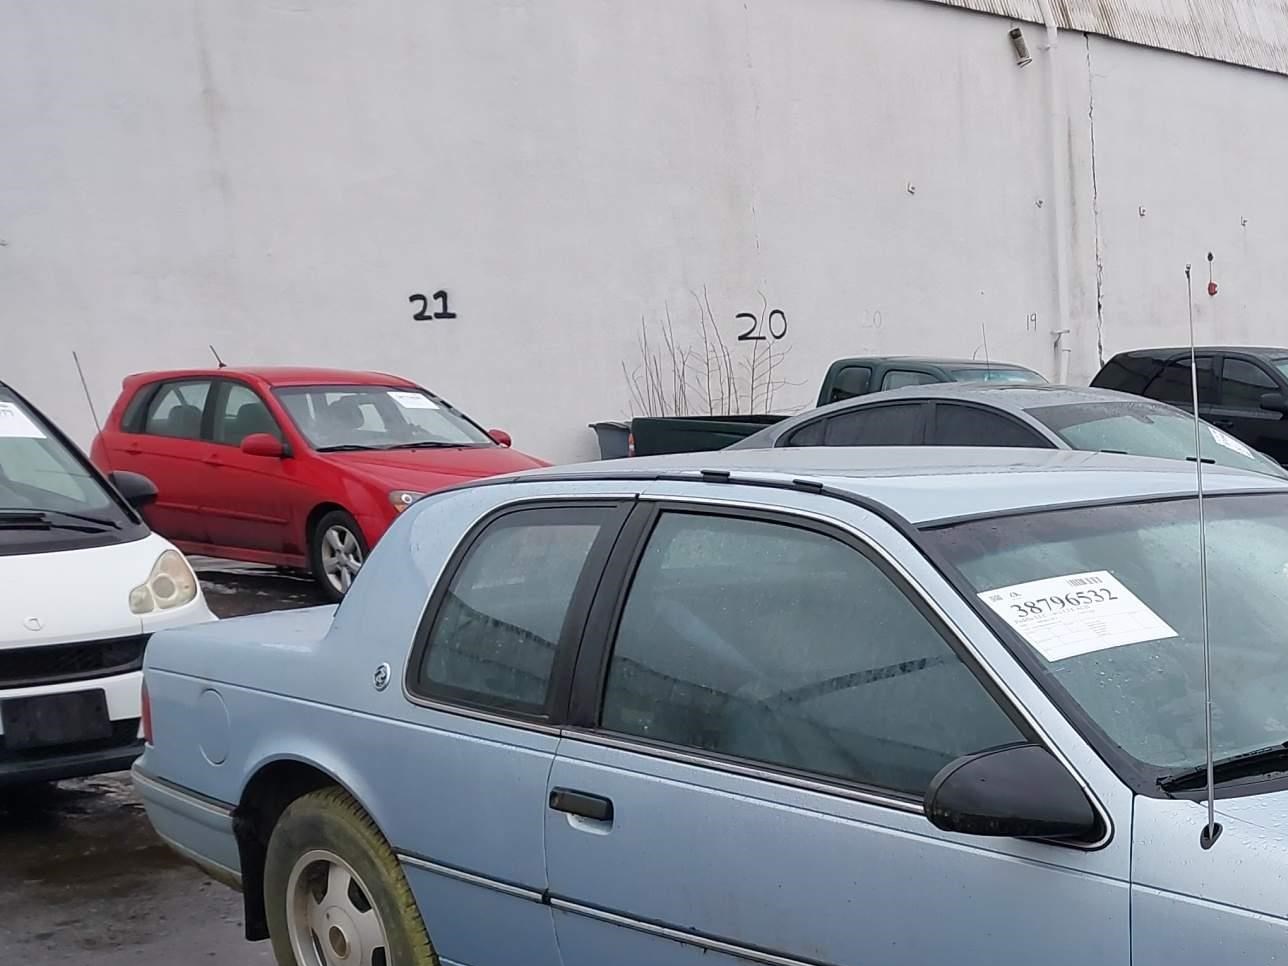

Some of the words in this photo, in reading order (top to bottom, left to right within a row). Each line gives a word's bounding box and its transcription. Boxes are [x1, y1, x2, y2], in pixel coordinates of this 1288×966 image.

[408, 290, 457, 321] 21
[735, 309, 788, 341] 20
[1026, 312, 1037, 332] 19
[1010, 588, 1119, 618] 38796532
